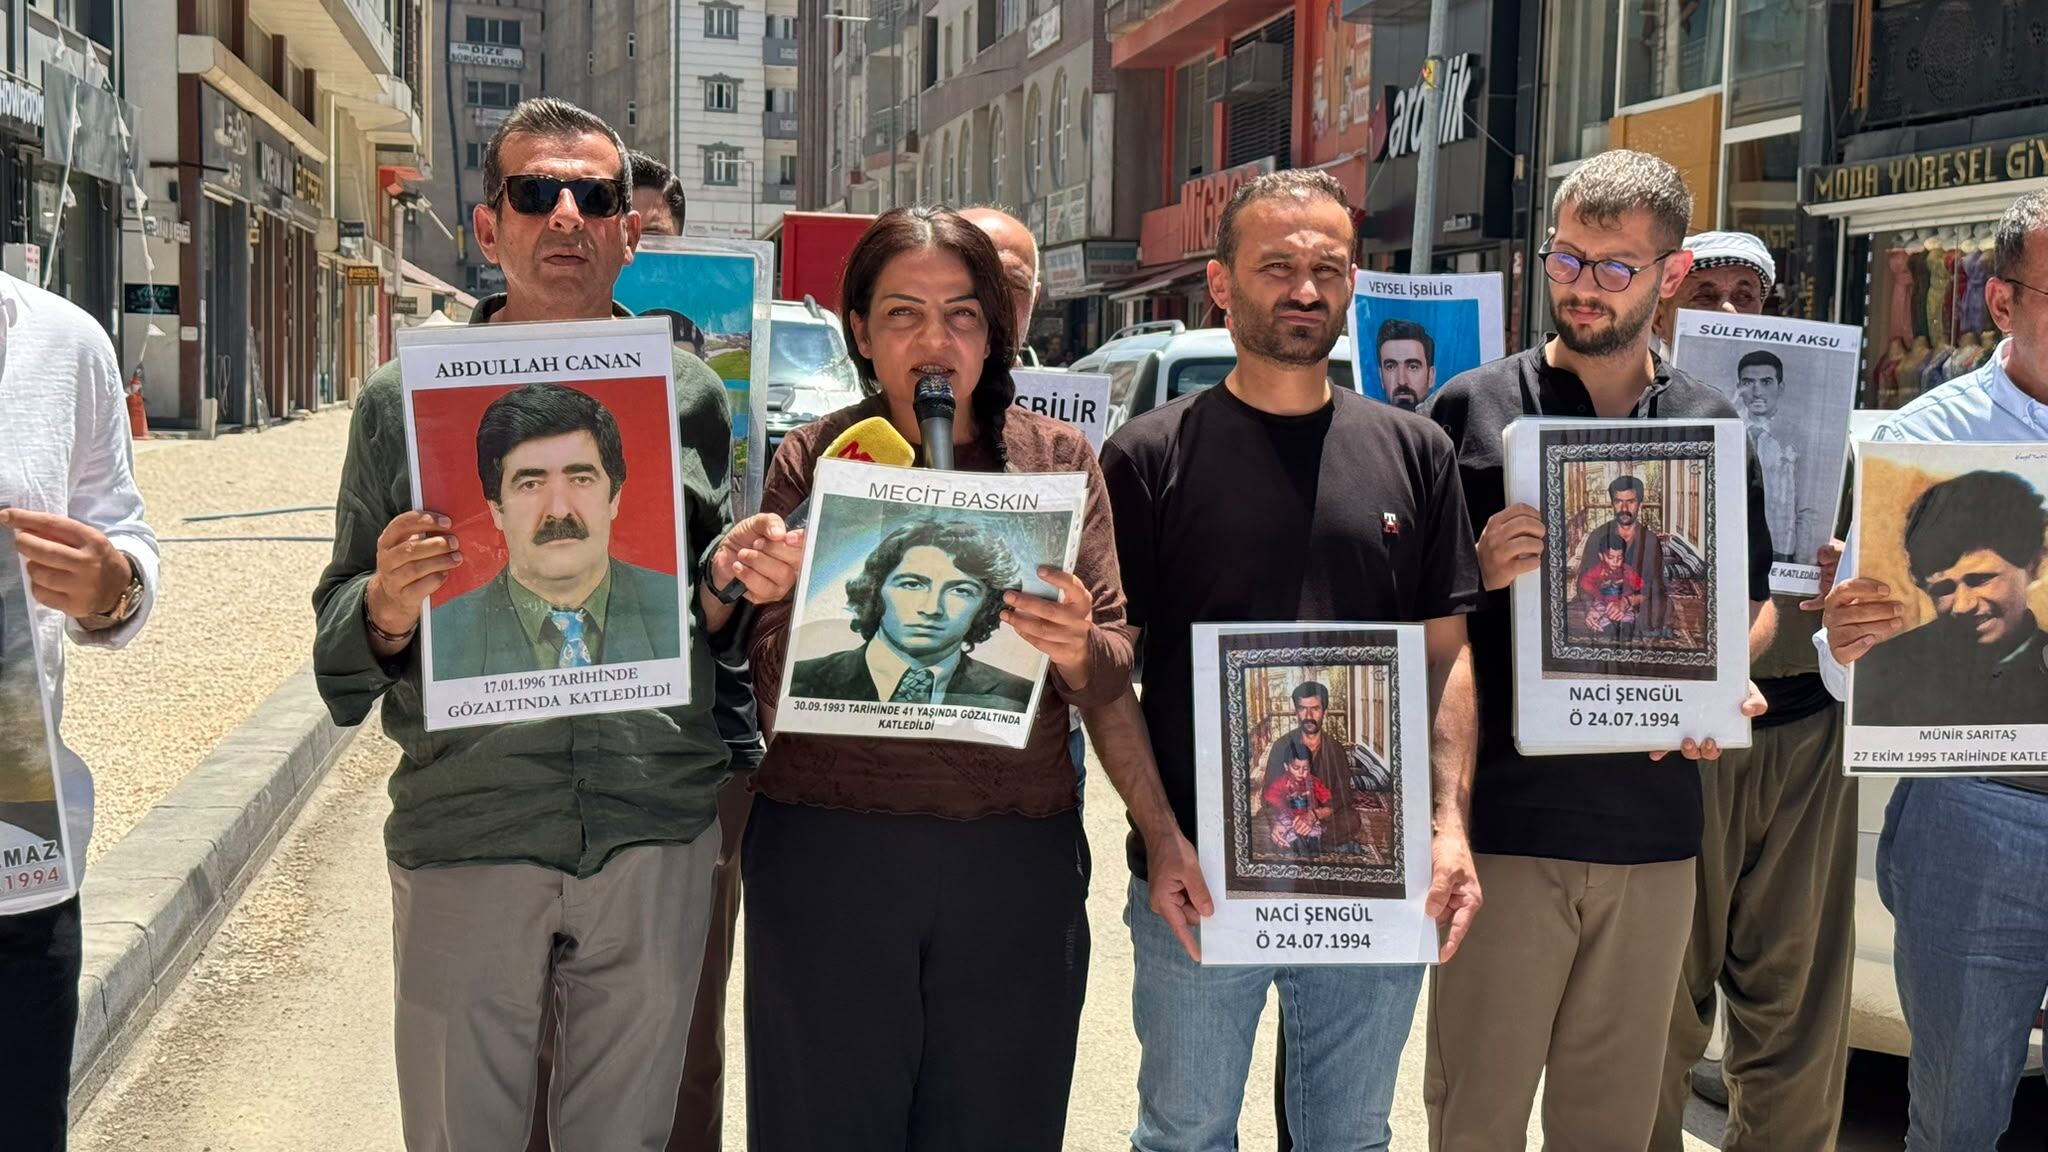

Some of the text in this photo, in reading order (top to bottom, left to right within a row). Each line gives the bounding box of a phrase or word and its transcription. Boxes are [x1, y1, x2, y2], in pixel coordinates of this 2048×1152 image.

[0, 79, 45, 127] HOWROOM
[1814, 164, 1879, 203] MODA
[1368, 281, 1453, 298] VEYSEL İŞBİLİR
[1699, 323, 1841, 348] SÜLEYMAN AKSU
[435, 352, 642, 379] ABDULLAH CANAN
[868, 482, 1039, 511] MECİT BASKIN
[484, 667, 639, 694] 17.01.1996 TARİHİNDE
[448, 682, 672, 718] GÖZALTINDA KATLEDİLDİ
[1569, 683, 1683, 705] NACİ ŞENGÜL
[794, 700, 846, 713] 30.09.1993
[848, 703, 901, 716] TARİHİNDE
[902, 706, 914, 716] 41
[917, 706, 958, 719] YAŞINDA
[1569, 708, 1680, 727] Ö 24.07.1994
[878, 718, 935, 731] KATLEDİLDİ
[1919, 728, 2017, 742] MÜNİR SARITAŞ
[1853, 750, 1868, 762] 27
[1871, 749, 1903, 762] EKİM
[1908, 751, 1937, 762] 1995
[1940, 749, 2007, 763] TARİHİNDE
[0, 841, 58, 868] MAZ
[1255, 903, 1374, 926] NACİ ŞENGÜL
[1256, 930, 1371, 949] Ö 24.07.1994
